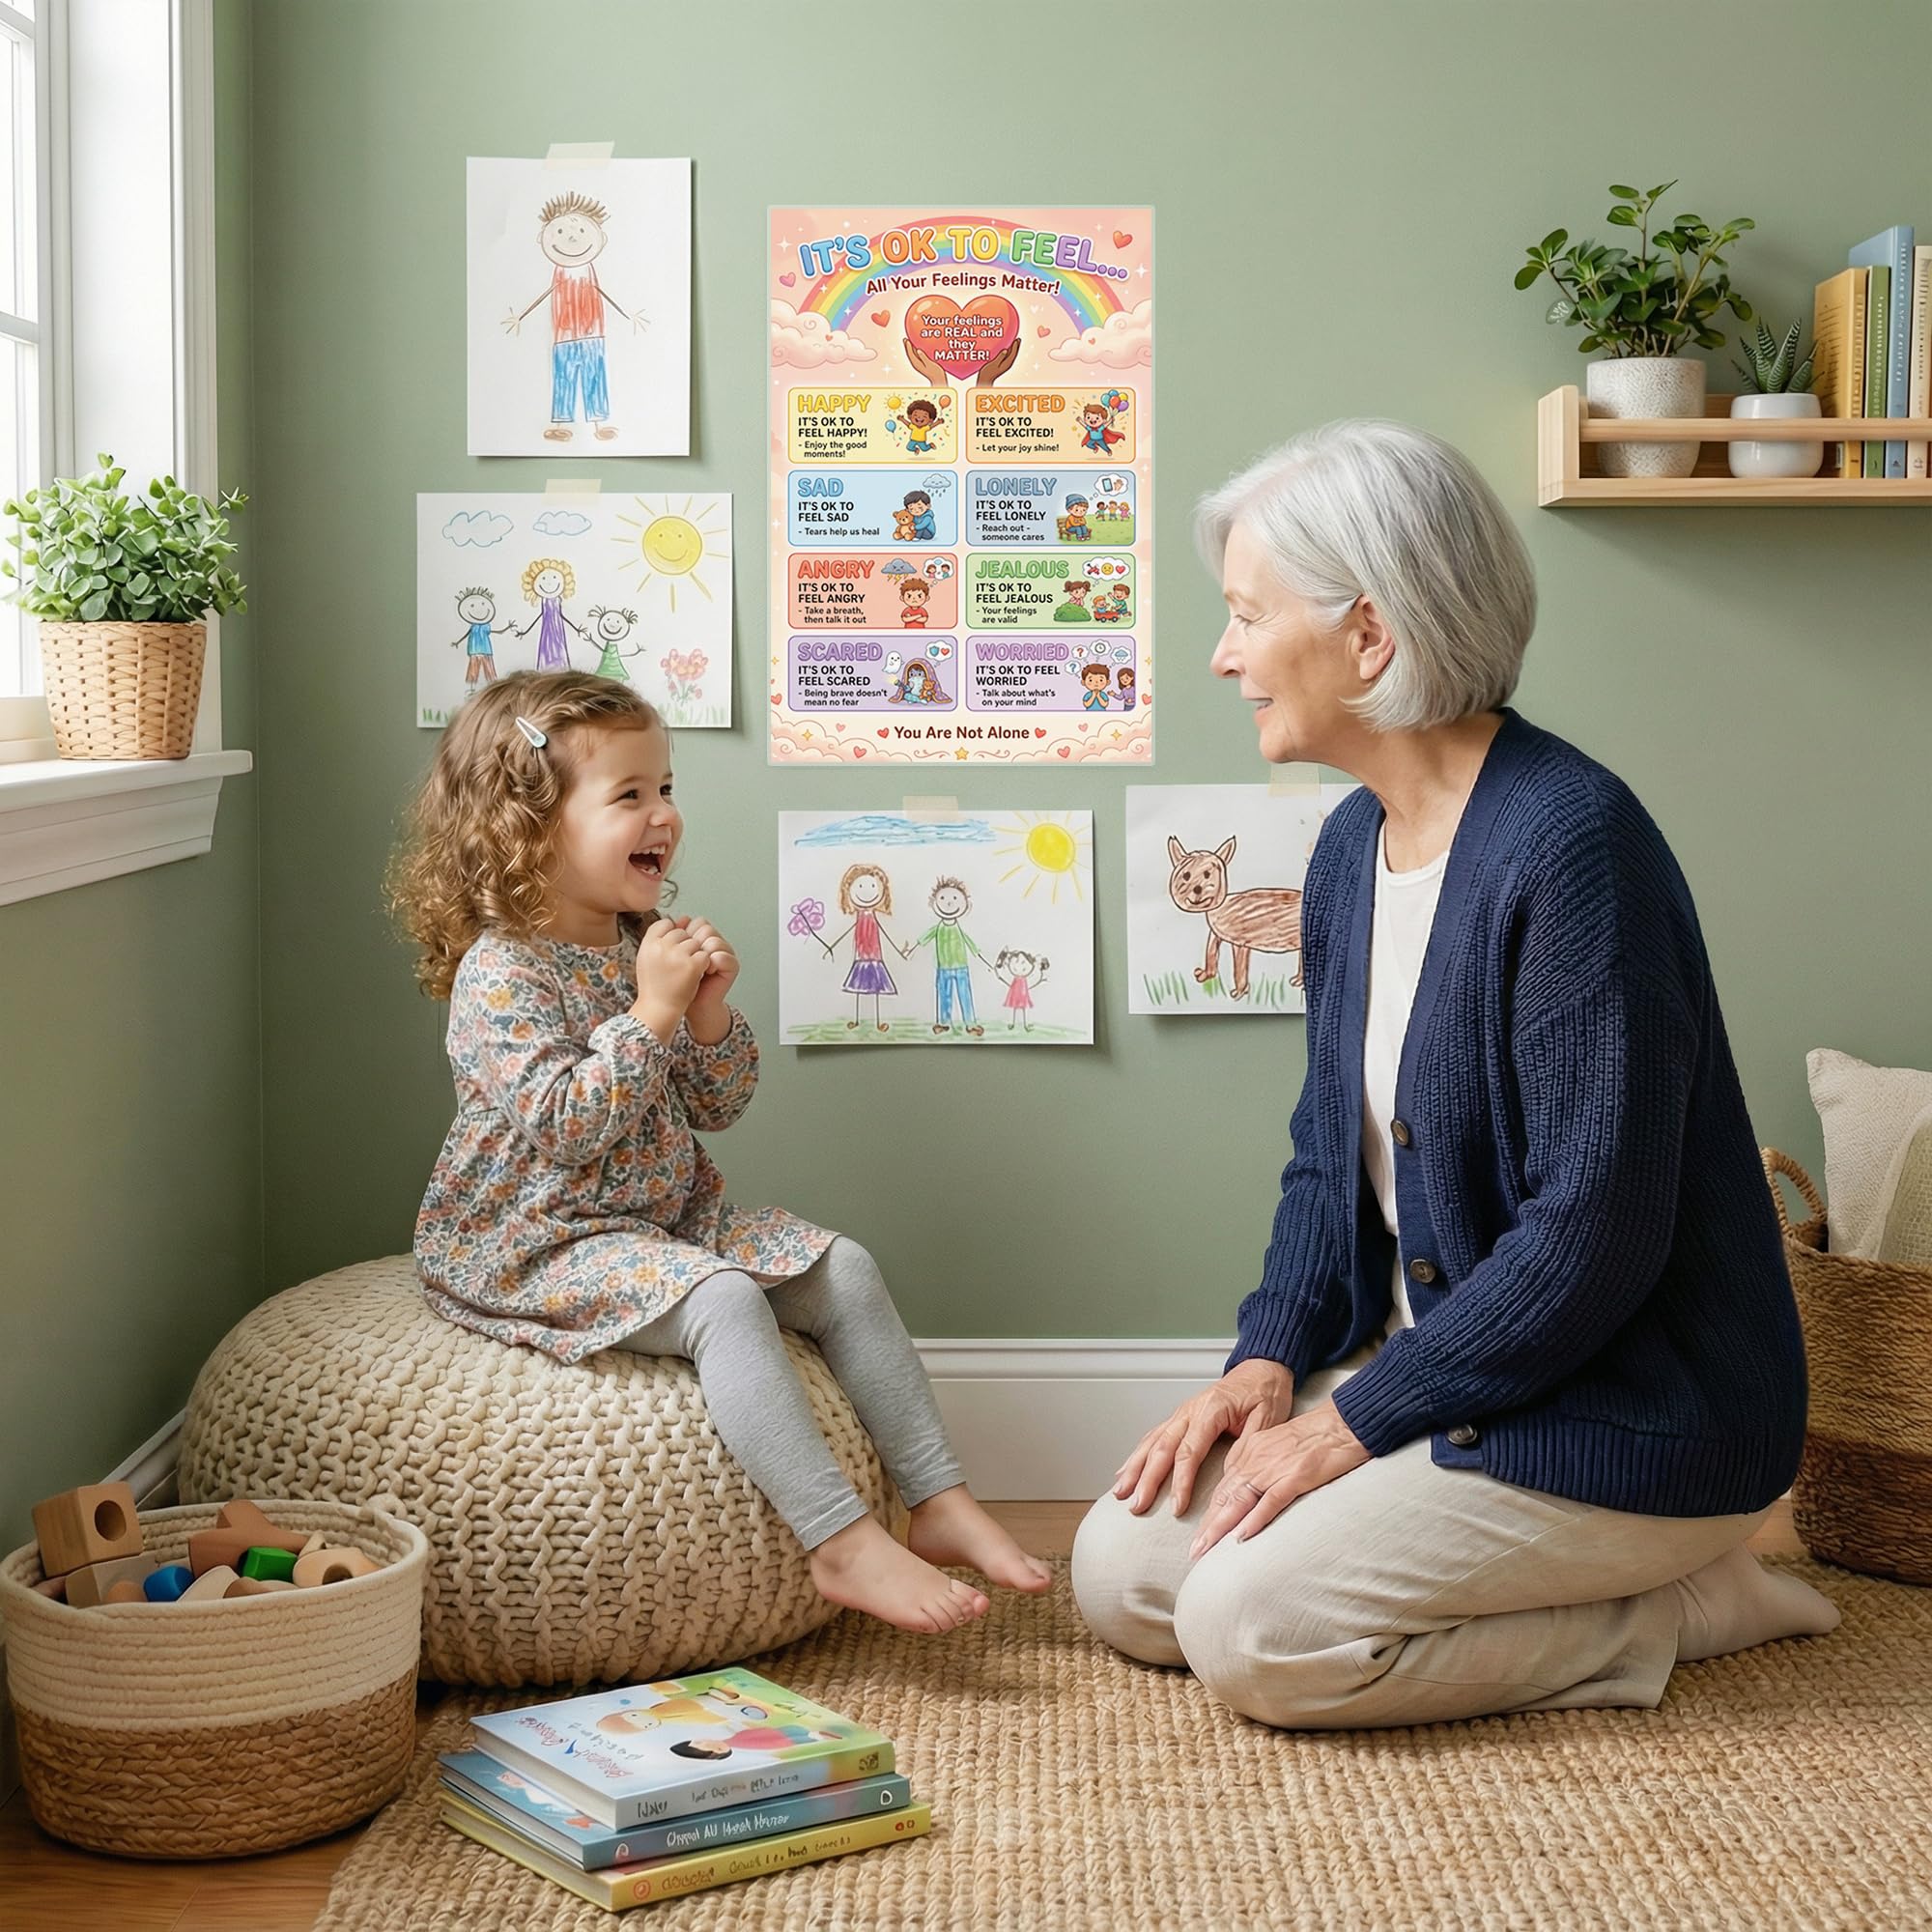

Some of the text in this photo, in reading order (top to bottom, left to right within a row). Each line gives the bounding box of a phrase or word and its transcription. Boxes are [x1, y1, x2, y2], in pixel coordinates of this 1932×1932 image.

[799, 226, 1128, 279] IT'S OK TO FEEL...
[867, 272, 1060, 294] All Your Feelings Matter!
[922, 315, 1002, 327] Your feelings
[945, 327, 977, 337] REAL
[980, 327, 1003, 337] and
[949, 340, 976, 351] they
[934, 351, 989, 360] MATTER!
[798, 394, 871, 413] HAPPY
[976, 394, 1065, 413] EXCITED
[798, 417, 854, 426] IT'S OK TO
[976, 417, 1032, 426] IT'S OK TO
[798, 428, 867, 437] FEEL HAPPY!
[976, 428, 1053, 437] FEEL EXCITED!
[805, 441, 827, 450] Enjoy
[846, 441, 867, 450] good
[1019, 444, 1032, 453] joy
[798, 478, 843, 497] SAD
[976, 478, 1057, 496] LONELY
[798, 501, 854, 511] IT'S OK TO
[976, 500, 1032, 509] IT'S OK TO
[798, 513, 849, 522] FEEL SAD
[976, 512, 1046, 521] FEEL LONELY
[829, 528, 848, 537] help
[798, 560, 874, 579] ANGRY
[976, 560, 1069, 579] JEALOUS
[798, 583, 854, 592] IT'S OK TO
[976, 583, 1032, 592] IT'S OK TO
[798, 594, 866, 603] FEEL ANGRY
[976, 594, 1053, 603] FEEL JEALOUS
[834, 607, 864, 615] breath,
[1004, 607, 1037, 616] feelings
[798, 642, 882, 662] SCARED
[976, 643, 1069, 661] WORRIED
[798, 666, 854, 674] IT'S OK TO
[976, 666, 1061, 674] IT'S OK TO FEEL
[798, 676, 870, 686] FEEL SCARED
[976, 676, 1027, 686] WORRIED
[805, 690, 828, 698] Being
[895, 726, 1030, 739] You Are Not Alone
